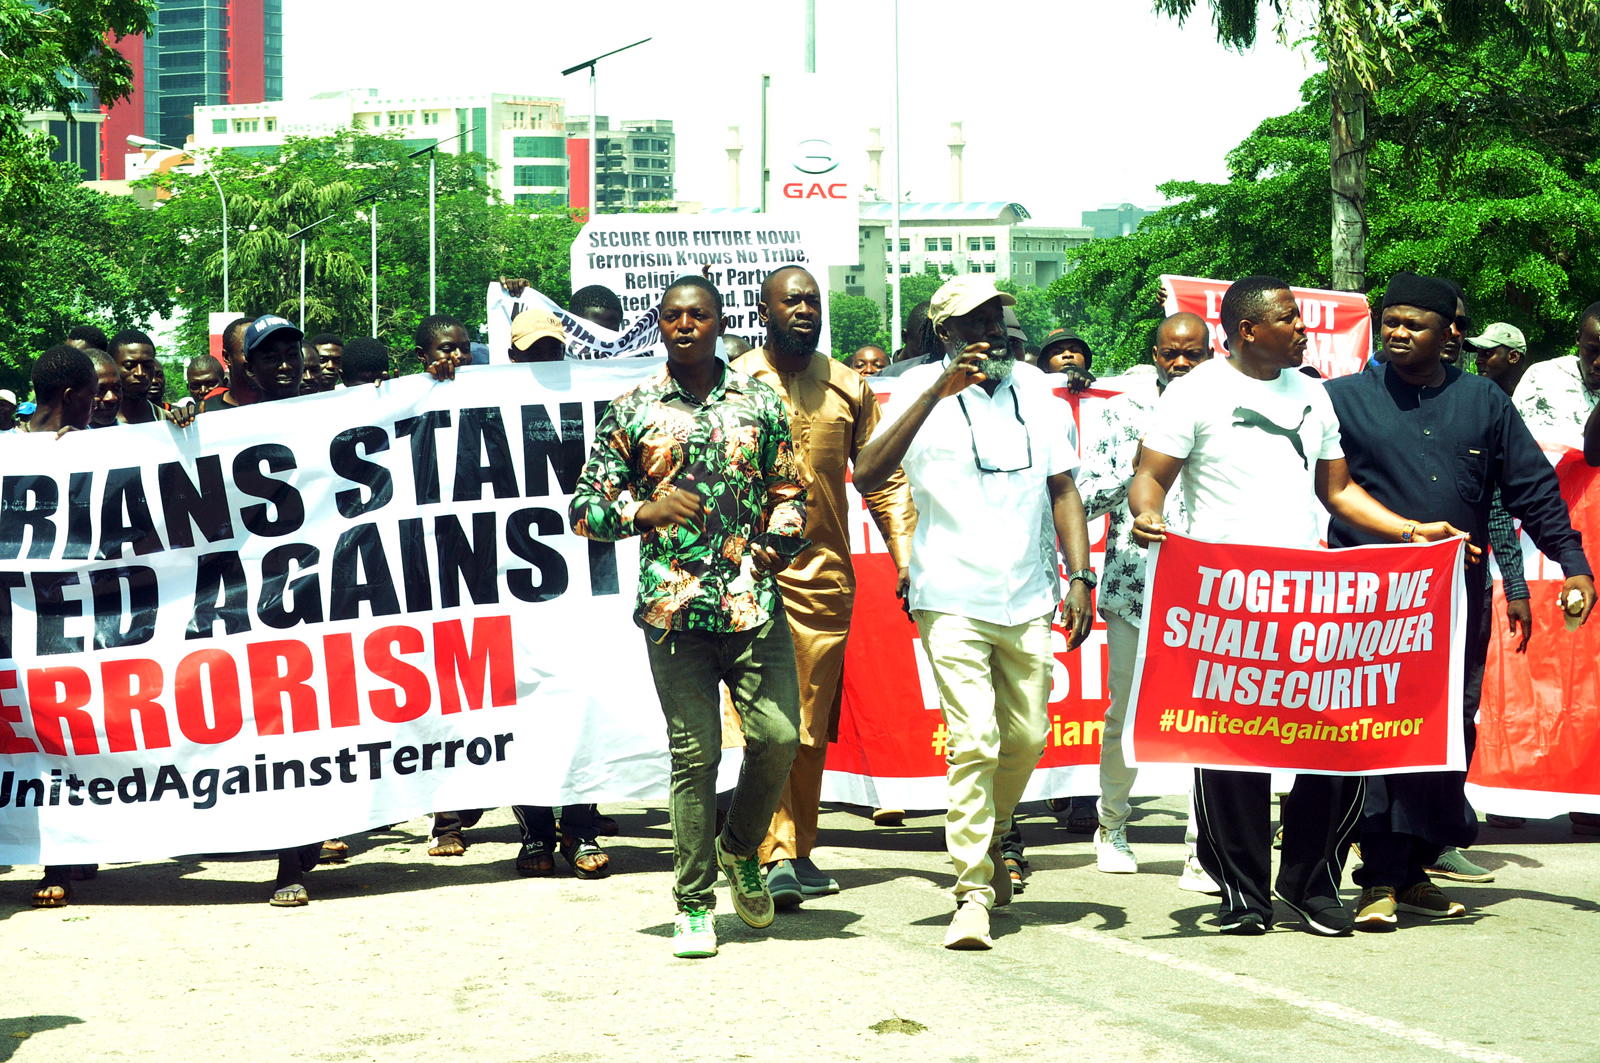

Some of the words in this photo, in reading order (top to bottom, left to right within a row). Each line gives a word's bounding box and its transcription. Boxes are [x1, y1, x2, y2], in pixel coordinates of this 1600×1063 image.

[783, 183, 847, 199] GAC
[588, 231, 651, 248] SECURE
[655, 231, 689, 247] OUR
[692, 230, 753, 247] FUTURE
[756, 230, 802, 245] NOW!
[586, 251, 672, 270] Terrorism
[676, 250, 733, 266] Knows
[736, 249, 758, 264] No
[761, 247, 809, 264] Tribe,
[625, 271, 681, 291] Religi
[330, 400, 613, 519] STAN
[1197, 565, 1381, 614] TOGETHER
[1385, 568, 1434, 612] WE
[1163, 606, 1280, 662] SHALL
[1289, 612, 1434, 664] CONQUER
[1191, 658, 1401, 712] INSECURITY
[1159, 709, 1424, 745] #UnitedAgainstTerror
